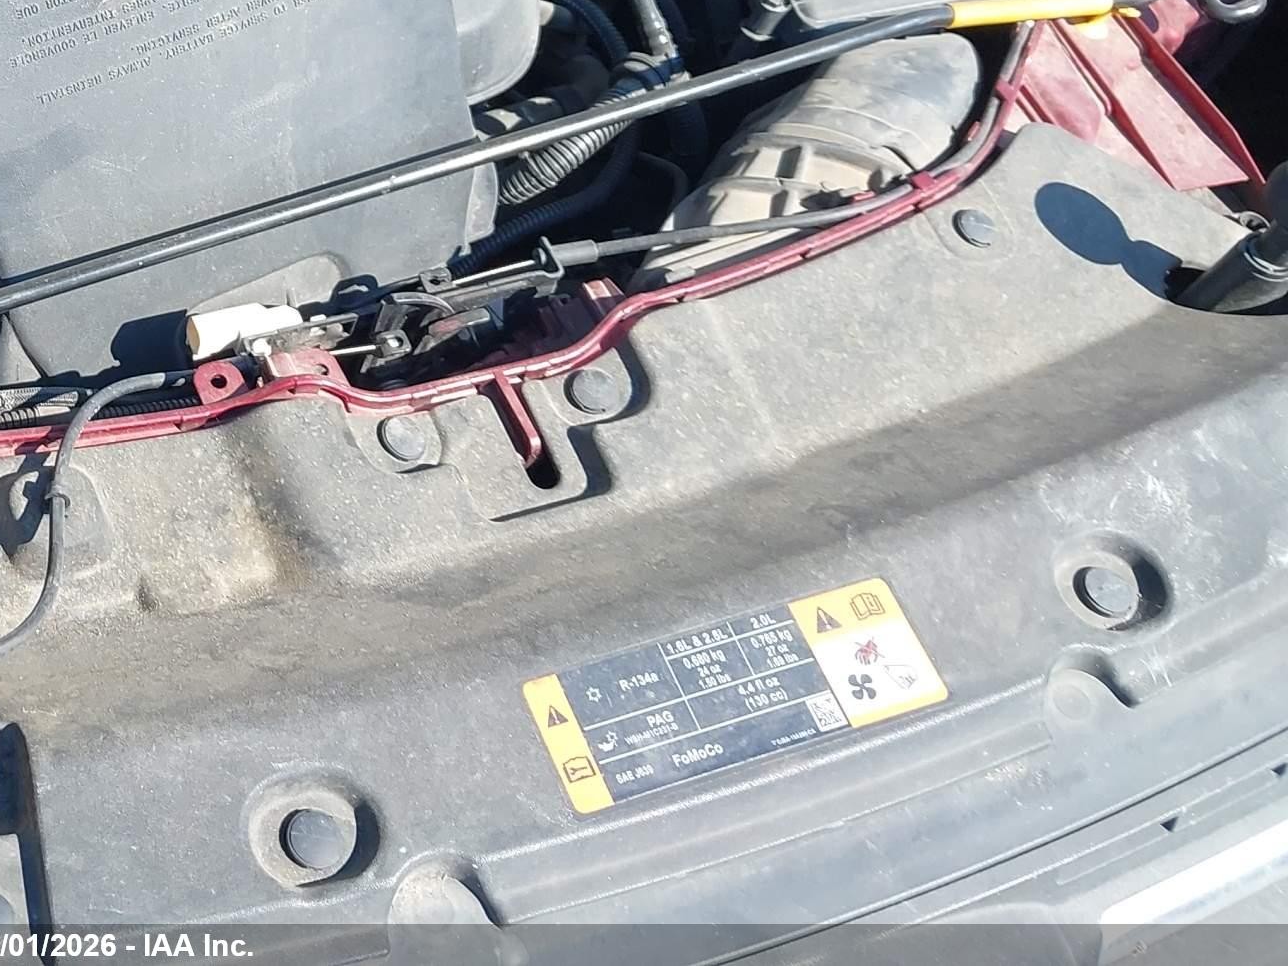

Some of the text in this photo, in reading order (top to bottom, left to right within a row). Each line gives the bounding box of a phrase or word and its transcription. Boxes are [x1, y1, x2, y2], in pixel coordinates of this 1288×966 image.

[16, 4, 39, 20] QUE
[206, 6, 241, 29] AFTER
[273, 3, 287, 16] TO
[22, 9, 114, 47] INTERVENTION.
[103, 11, 155, 36] ENLEVER
[219, 12, 269, 39] SERVICE
[82, 31, 98, 44] LE
[10, 37, 76, 68] COUVERCLE
[108, 56, 152, 81] ALWAYS
[36, 73, 102, 105] REINSTALL
[750, 614, 777, 629] 2.0L
[777, 629, 793, 642] kg
[667, 638, 692, 654] 1.6L
[765, 643, 789, 657] 27 oz
[682, 649, 726, 669] 0.680 kg
[697, 664, 722, 677] 24 oz
[716, 673, 731, 685] lbs
[619, 673, 660, 691] R-134a
[737, 682, 757, 695] 4.4
[765, 677, 780, 687] oz
[745, 687, 789, 712] (130 cc)
[646, 711, 674, 728] PAG
[672, 743, 724, 767] FoMoCo
[616, 770, 635, 784] SAE
